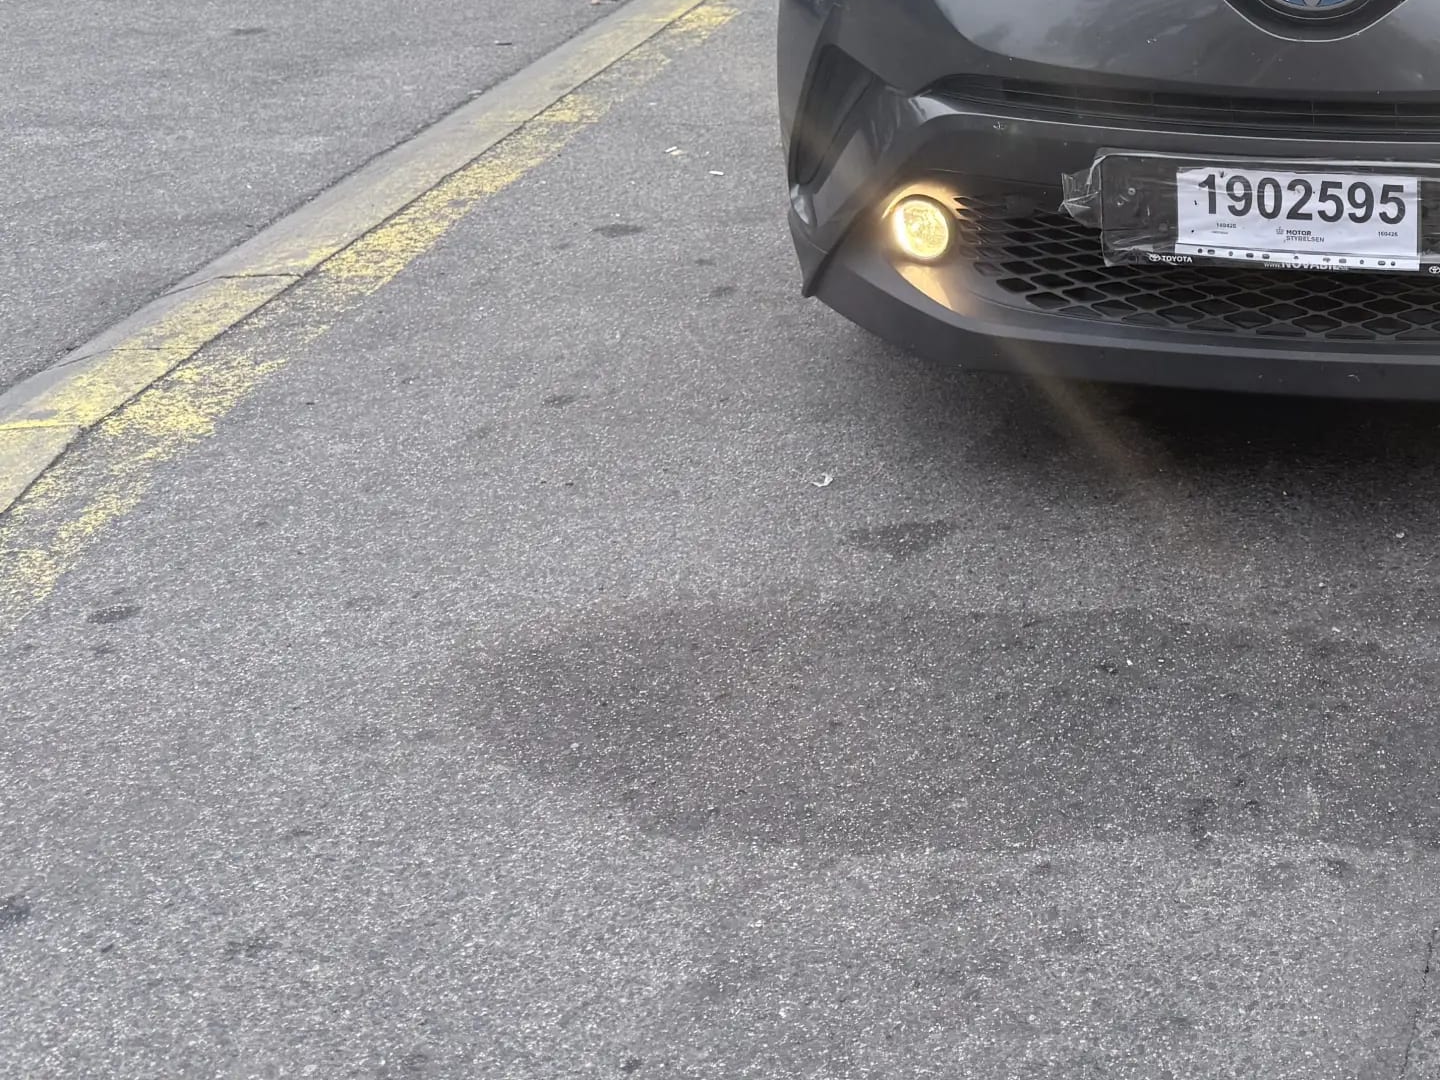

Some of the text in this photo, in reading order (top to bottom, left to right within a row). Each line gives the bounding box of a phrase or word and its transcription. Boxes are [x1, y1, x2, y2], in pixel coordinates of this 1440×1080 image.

[1198, 174, 1406, 225] 1902595
[1286, 235, 1325, 243] STYRELSEN
[1161, 254, 1193, 264] TOYOTA
